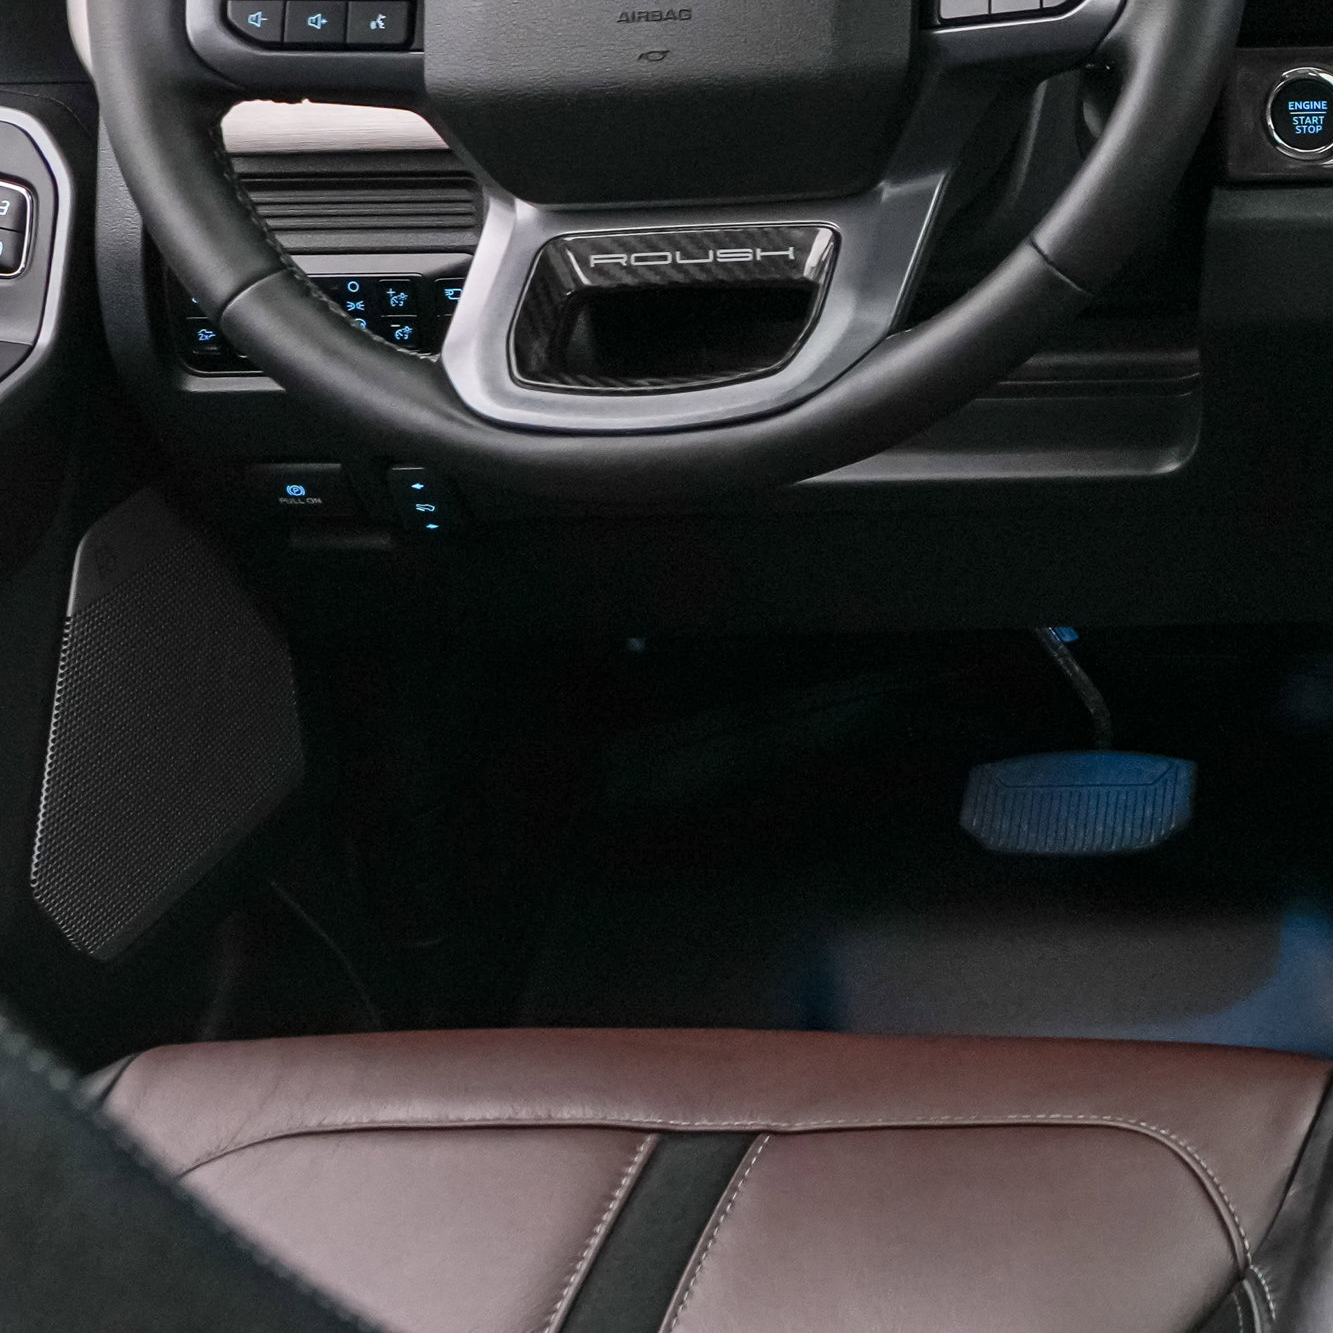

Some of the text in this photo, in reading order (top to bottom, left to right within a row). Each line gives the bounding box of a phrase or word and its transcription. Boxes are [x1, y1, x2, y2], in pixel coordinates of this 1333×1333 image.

[616, 9, 692, 23] AIRBAG
[1288, 101, 1328, 110] ENGINE
[1292, 116, 1325, 124] START
[1295, 125, 1322, 134] STOP
[590, 247, 795, 268] ROUSH
